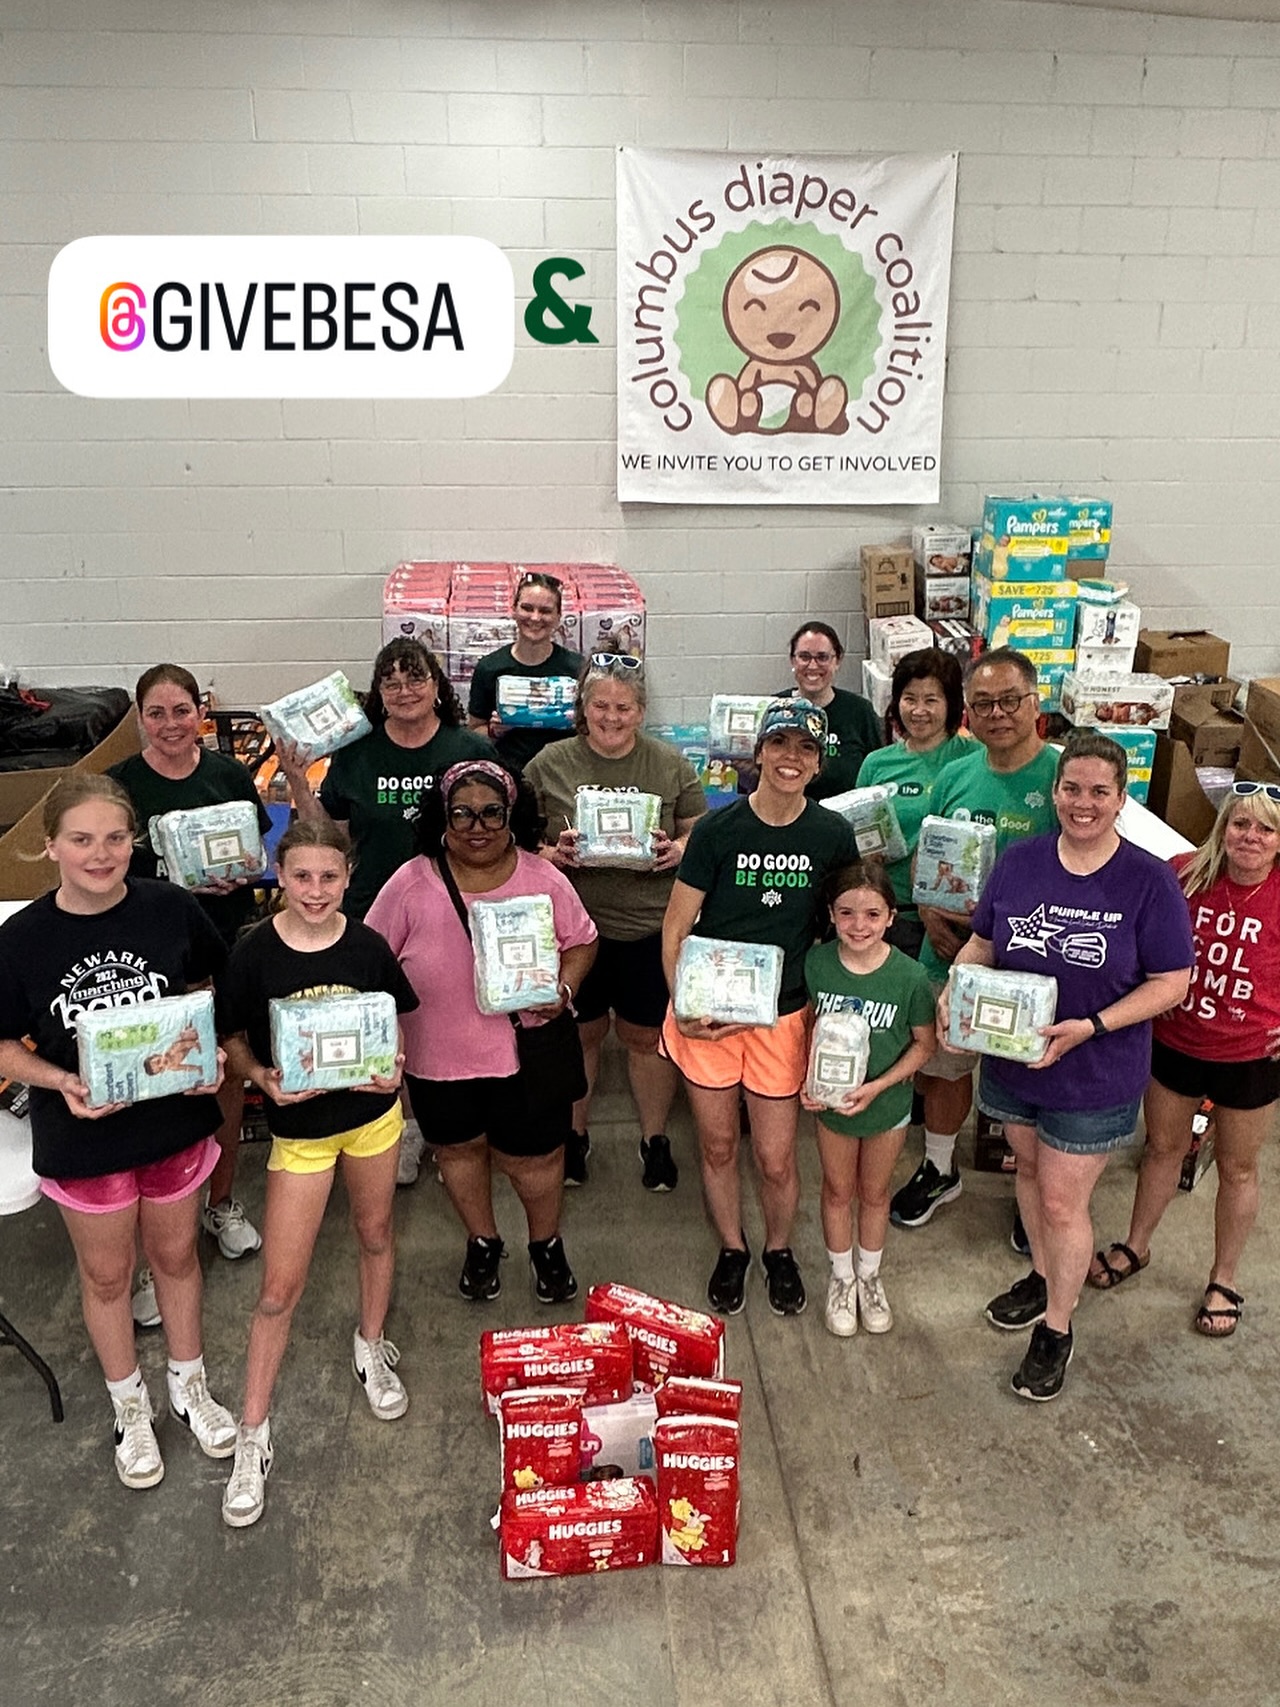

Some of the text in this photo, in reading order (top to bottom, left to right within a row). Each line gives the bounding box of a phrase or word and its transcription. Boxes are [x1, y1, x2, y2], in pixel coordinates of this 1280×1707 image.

[631, 162, 933, 434] columbus diaper coalition
[621, 455, 936, 471] WE INVITE YOU TO GET INVOLVED
[1006, 515, 1059, 535] Pampers
[1068, 519, 1101, 530] mpers
[998, 585, 1025, 595] SAVE
[1011, 604, 1055, 619] Pampers
[378, 775, 434, 790] DO GOO
[902, 784, 919, 794] the
[377, 791, 398, 804] BE
[1001, 817, 1031, 830] Good
[737, 854, 813, 871] DO GOOD.
[735, 870, 812, 887] BE GOOD.
[1049, 905, 1101, 921] PURPLE
[1103, 912, 1123, 922] UP
[1195, 906, 1262, 944] FOR
[60, 950, 148, 988] NEWARK
[72, 976, 144, 1000] marching
[815, 992, 898, 1028] THE RUN
[492, 1328, 550, 1340] HUGGIES
[628, 1325, 678, 1354] UGGIES
[524, 1359, 595, 1377] HUGGIES
[612, 1389, 619, 1399] 1
[507, 1422, 578, 1439] HUGGIES
[663, 1453, 735, 1471] HUGGIES
[515, 1488, 576, 1507] HUGGIES
[549, 1520, 622, 1540] HUGGIES
[637, 1552, 644, 1562] 1
[721, 1550, 730, 1562] 1
